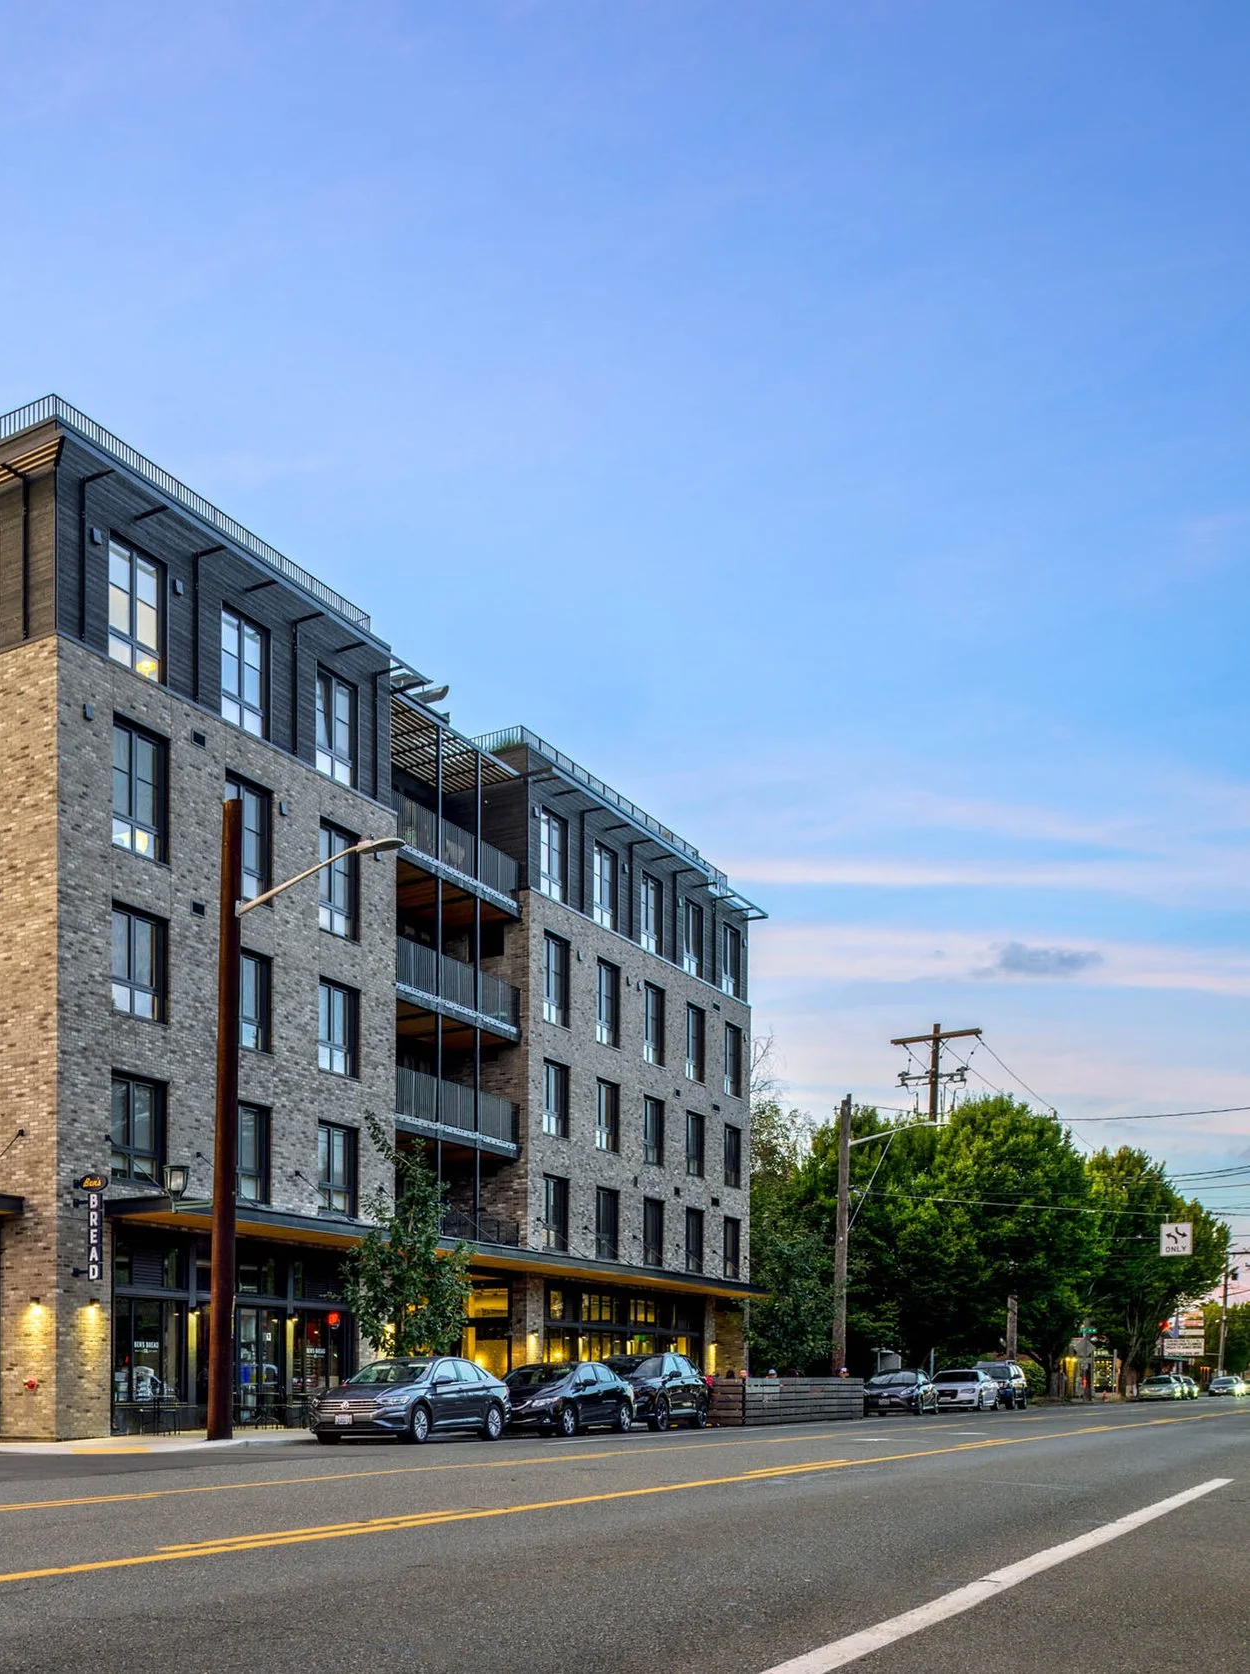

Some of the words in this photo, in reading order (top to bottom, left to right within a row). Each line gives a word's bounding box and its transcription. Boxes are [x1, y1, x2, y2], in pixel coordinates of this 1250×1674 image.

[82, 1177, 102, 1188] Ben's
[89, 1193, 99, 1280] BREAD
[1165, 1245, 1186, 1253] ONLY
